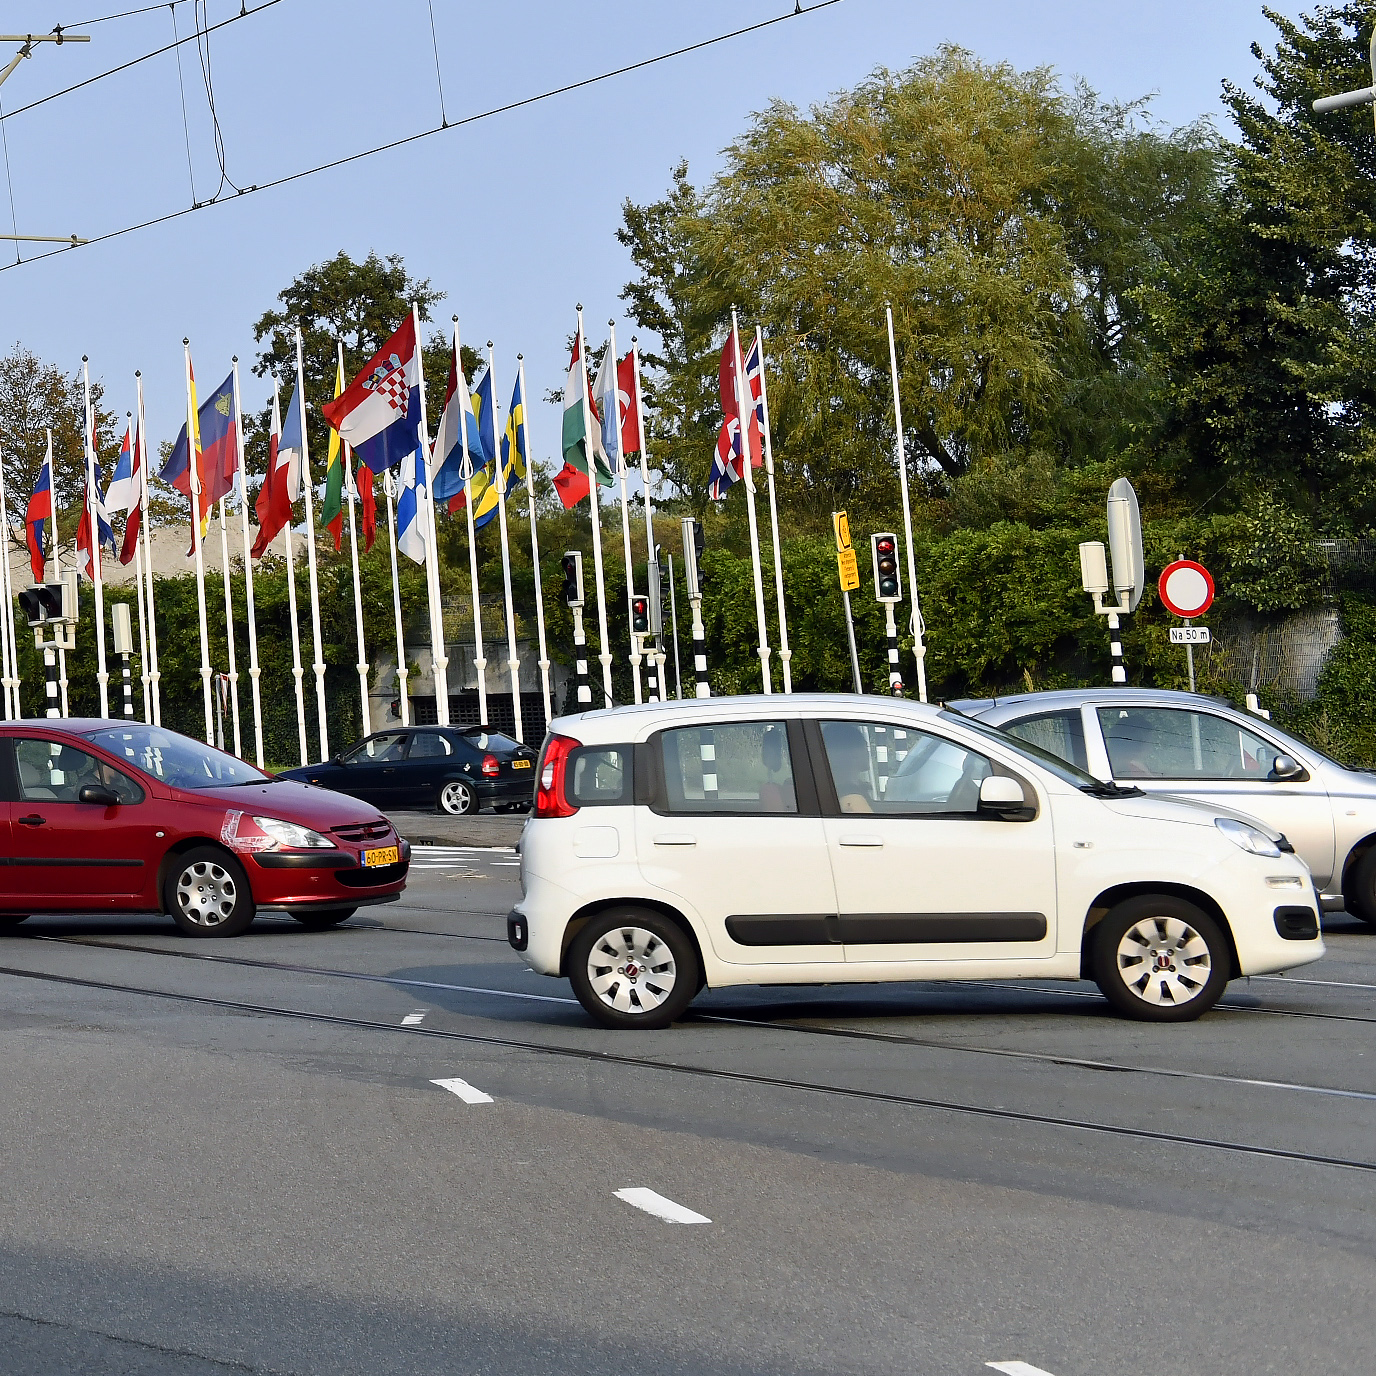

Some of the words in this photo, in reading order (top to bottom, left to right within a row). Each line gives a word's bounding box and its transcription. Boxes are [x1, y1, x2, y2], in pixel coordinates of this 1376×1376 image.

[1171, 630, 1183, 640] Na
[1185, 629, 1197, 640] 50
[1200, 631, 1208, 640] m
